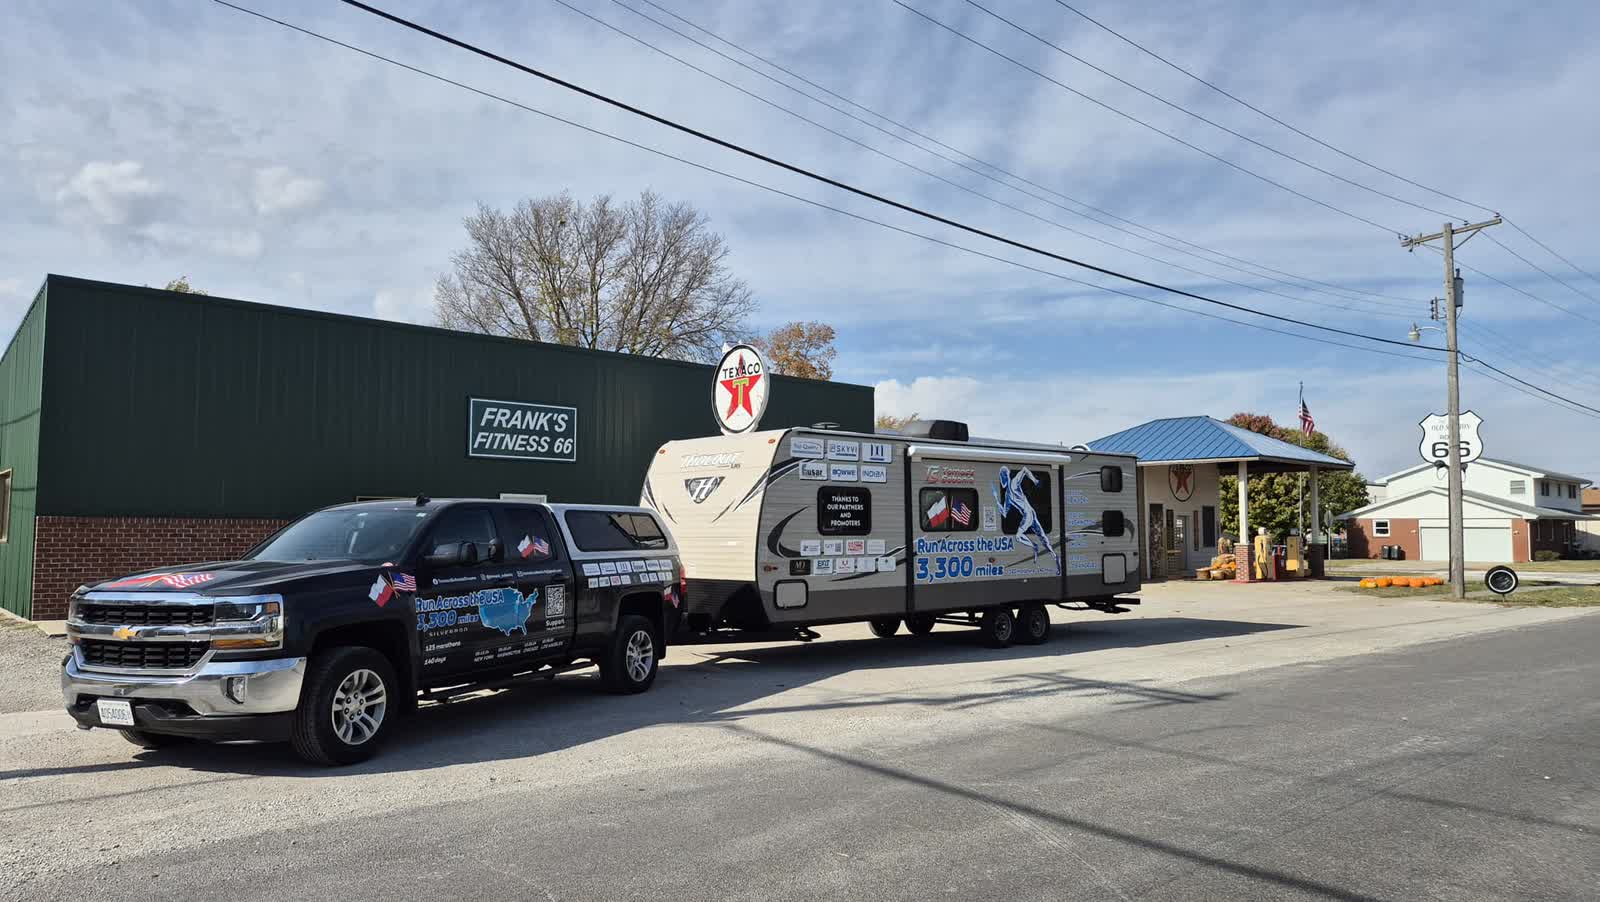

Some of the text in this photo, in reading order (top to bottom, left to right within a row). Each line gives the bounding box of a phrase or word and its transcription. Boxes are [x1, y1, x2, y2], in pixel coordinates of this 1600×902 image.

[722, 362, 761, 380] TEXACO
[480, 407, 569, 433] FRANK'S
[473, 431, 574, 454] FITNESS 66
[826, 503, 839, 511] OUR
[831, 495, 852, 503] THANKS
[830, 519, 862, 527] PROMOTERS
[916, 536, 1014, 554] Run Across the USA
[916, 556, 1004, 583] 3,300 miles
[415, 589, 504, 613] Run Across the USA
